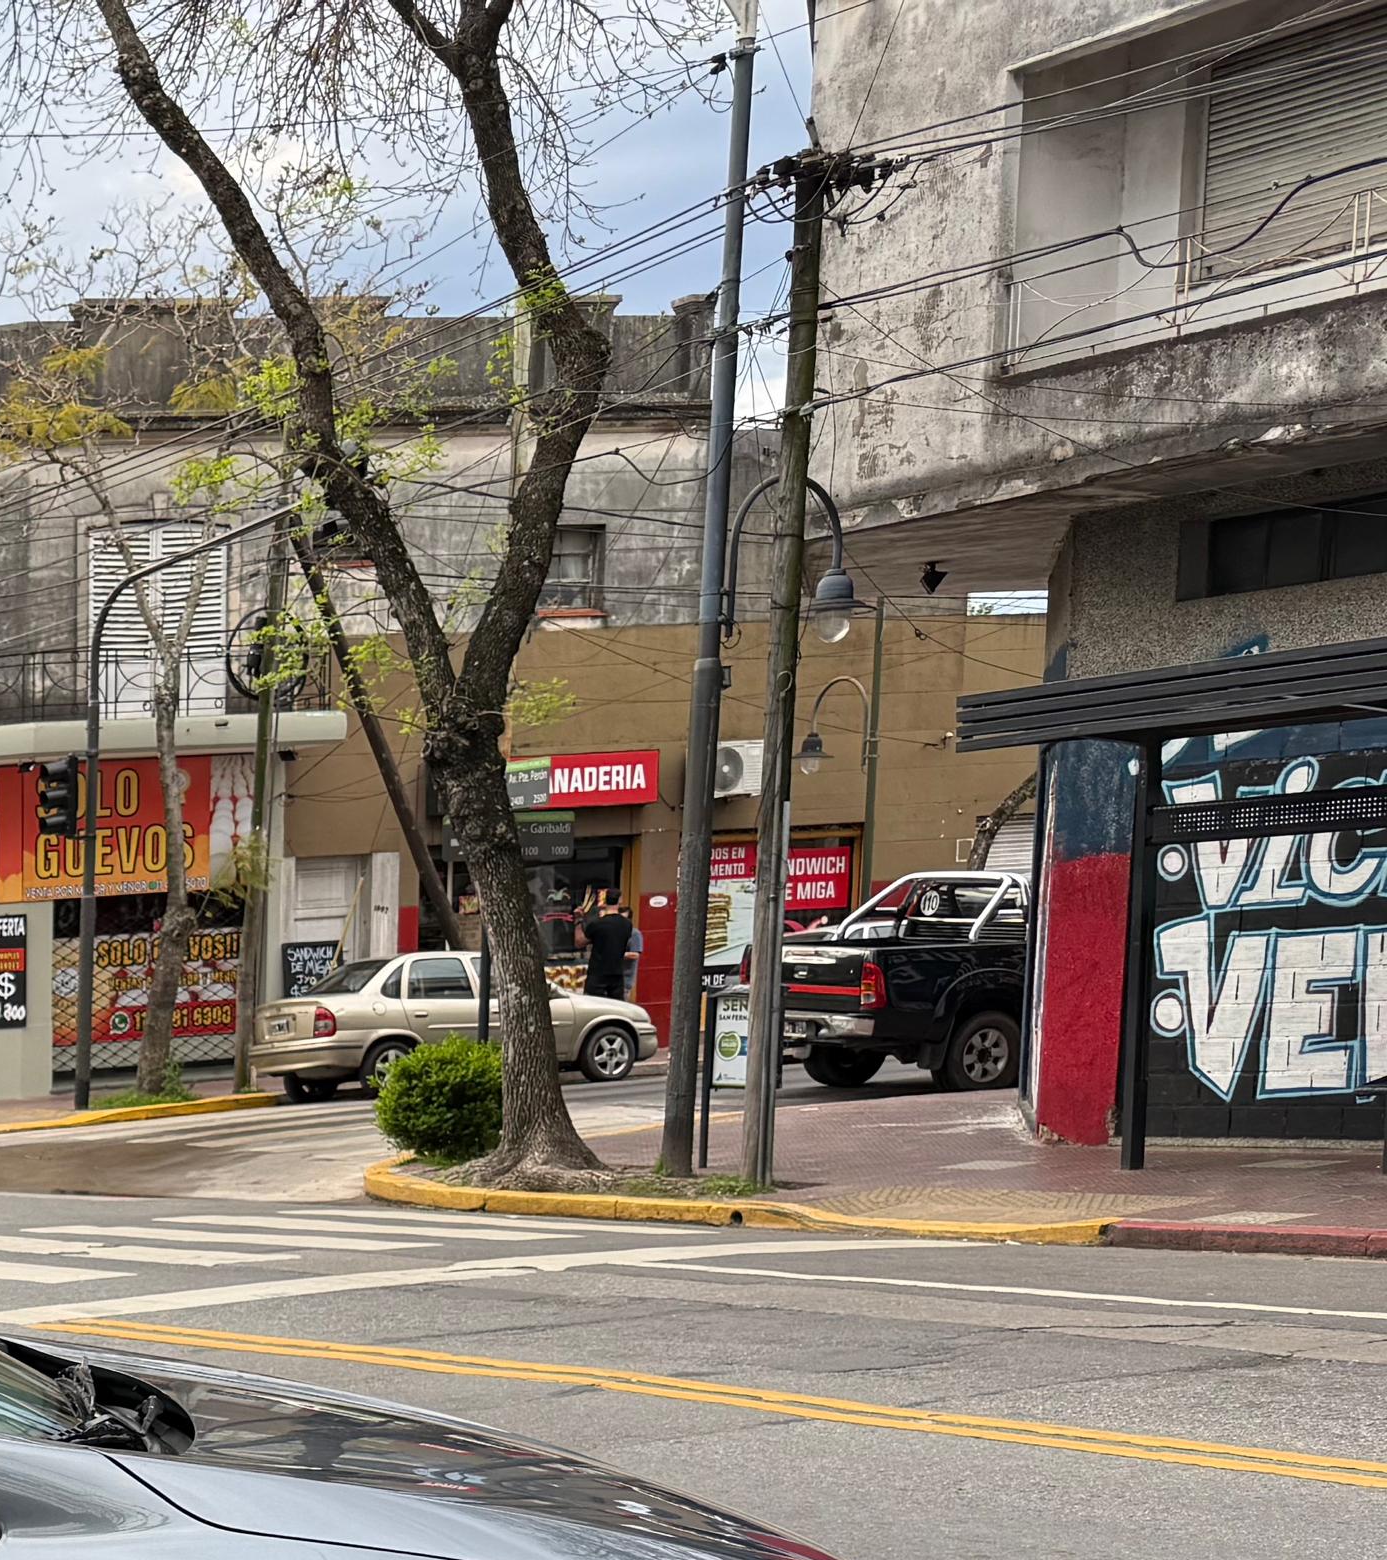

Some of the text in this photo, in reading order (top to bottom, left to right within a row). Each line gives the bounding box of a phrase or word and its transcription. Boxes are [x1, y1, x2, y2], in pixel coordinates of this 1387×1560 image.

[530, 823, 571, 834] Garibaldi
[521, 846, 569, 856] 1100 1000
[732, 847, 746, 859] EN
[115, 880, 148, 892] MENOR
[797, 882, 835, 900] MIGA
[95, 938, 147, 968] SOLO
[287, 945, 333, 961] SANDWICH
[291, 962, 332, 976] DE MIGA
